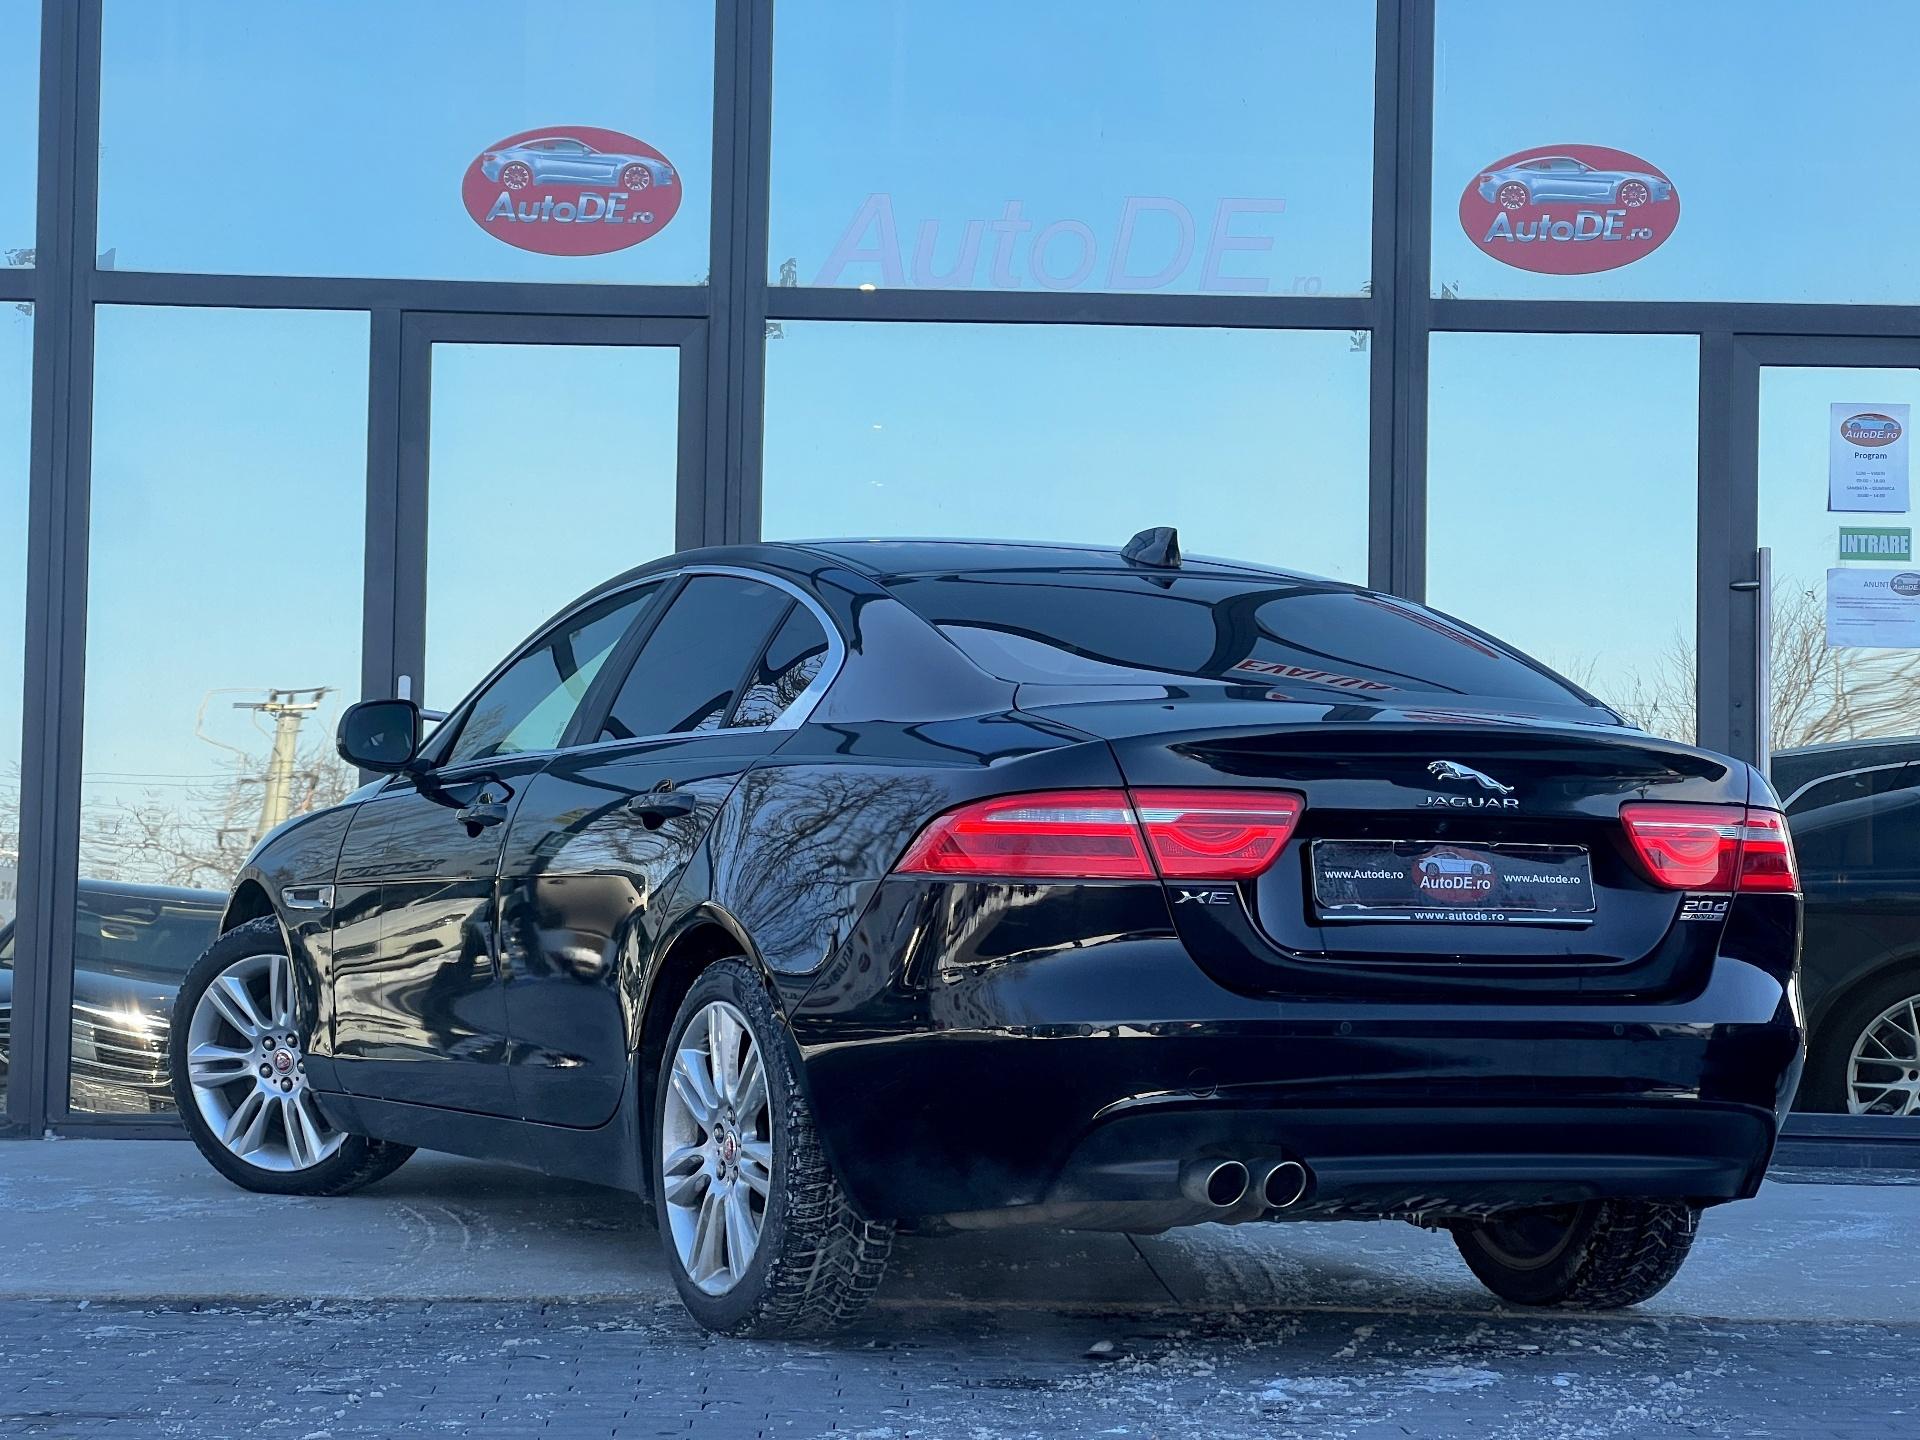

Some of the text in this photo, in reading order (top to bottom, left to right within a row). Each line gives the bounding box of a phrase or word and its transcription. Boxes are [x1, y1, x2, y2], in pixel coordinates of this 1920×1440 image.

[486, 191, 654, 224] AutoDE.ro
[1483, 209, 1653, 242] AutoDE.ro
[1845, 430, 1898, 439] AutoDE.ro
[1854, 452, 1888, 460] Program
[1841, 534, 1909, 554] INTRARE
[1416, 796, 1520, 809] JAGUAR
[1324, 869, 1581, 890] www.Autode.ro AutoDE.ro www.Autode.ro
[1174, 890, 1235, 905] XE
[1683, 900, 1729, 911] 20d
[1414, 910, 1505, 921] www.autode.ro
